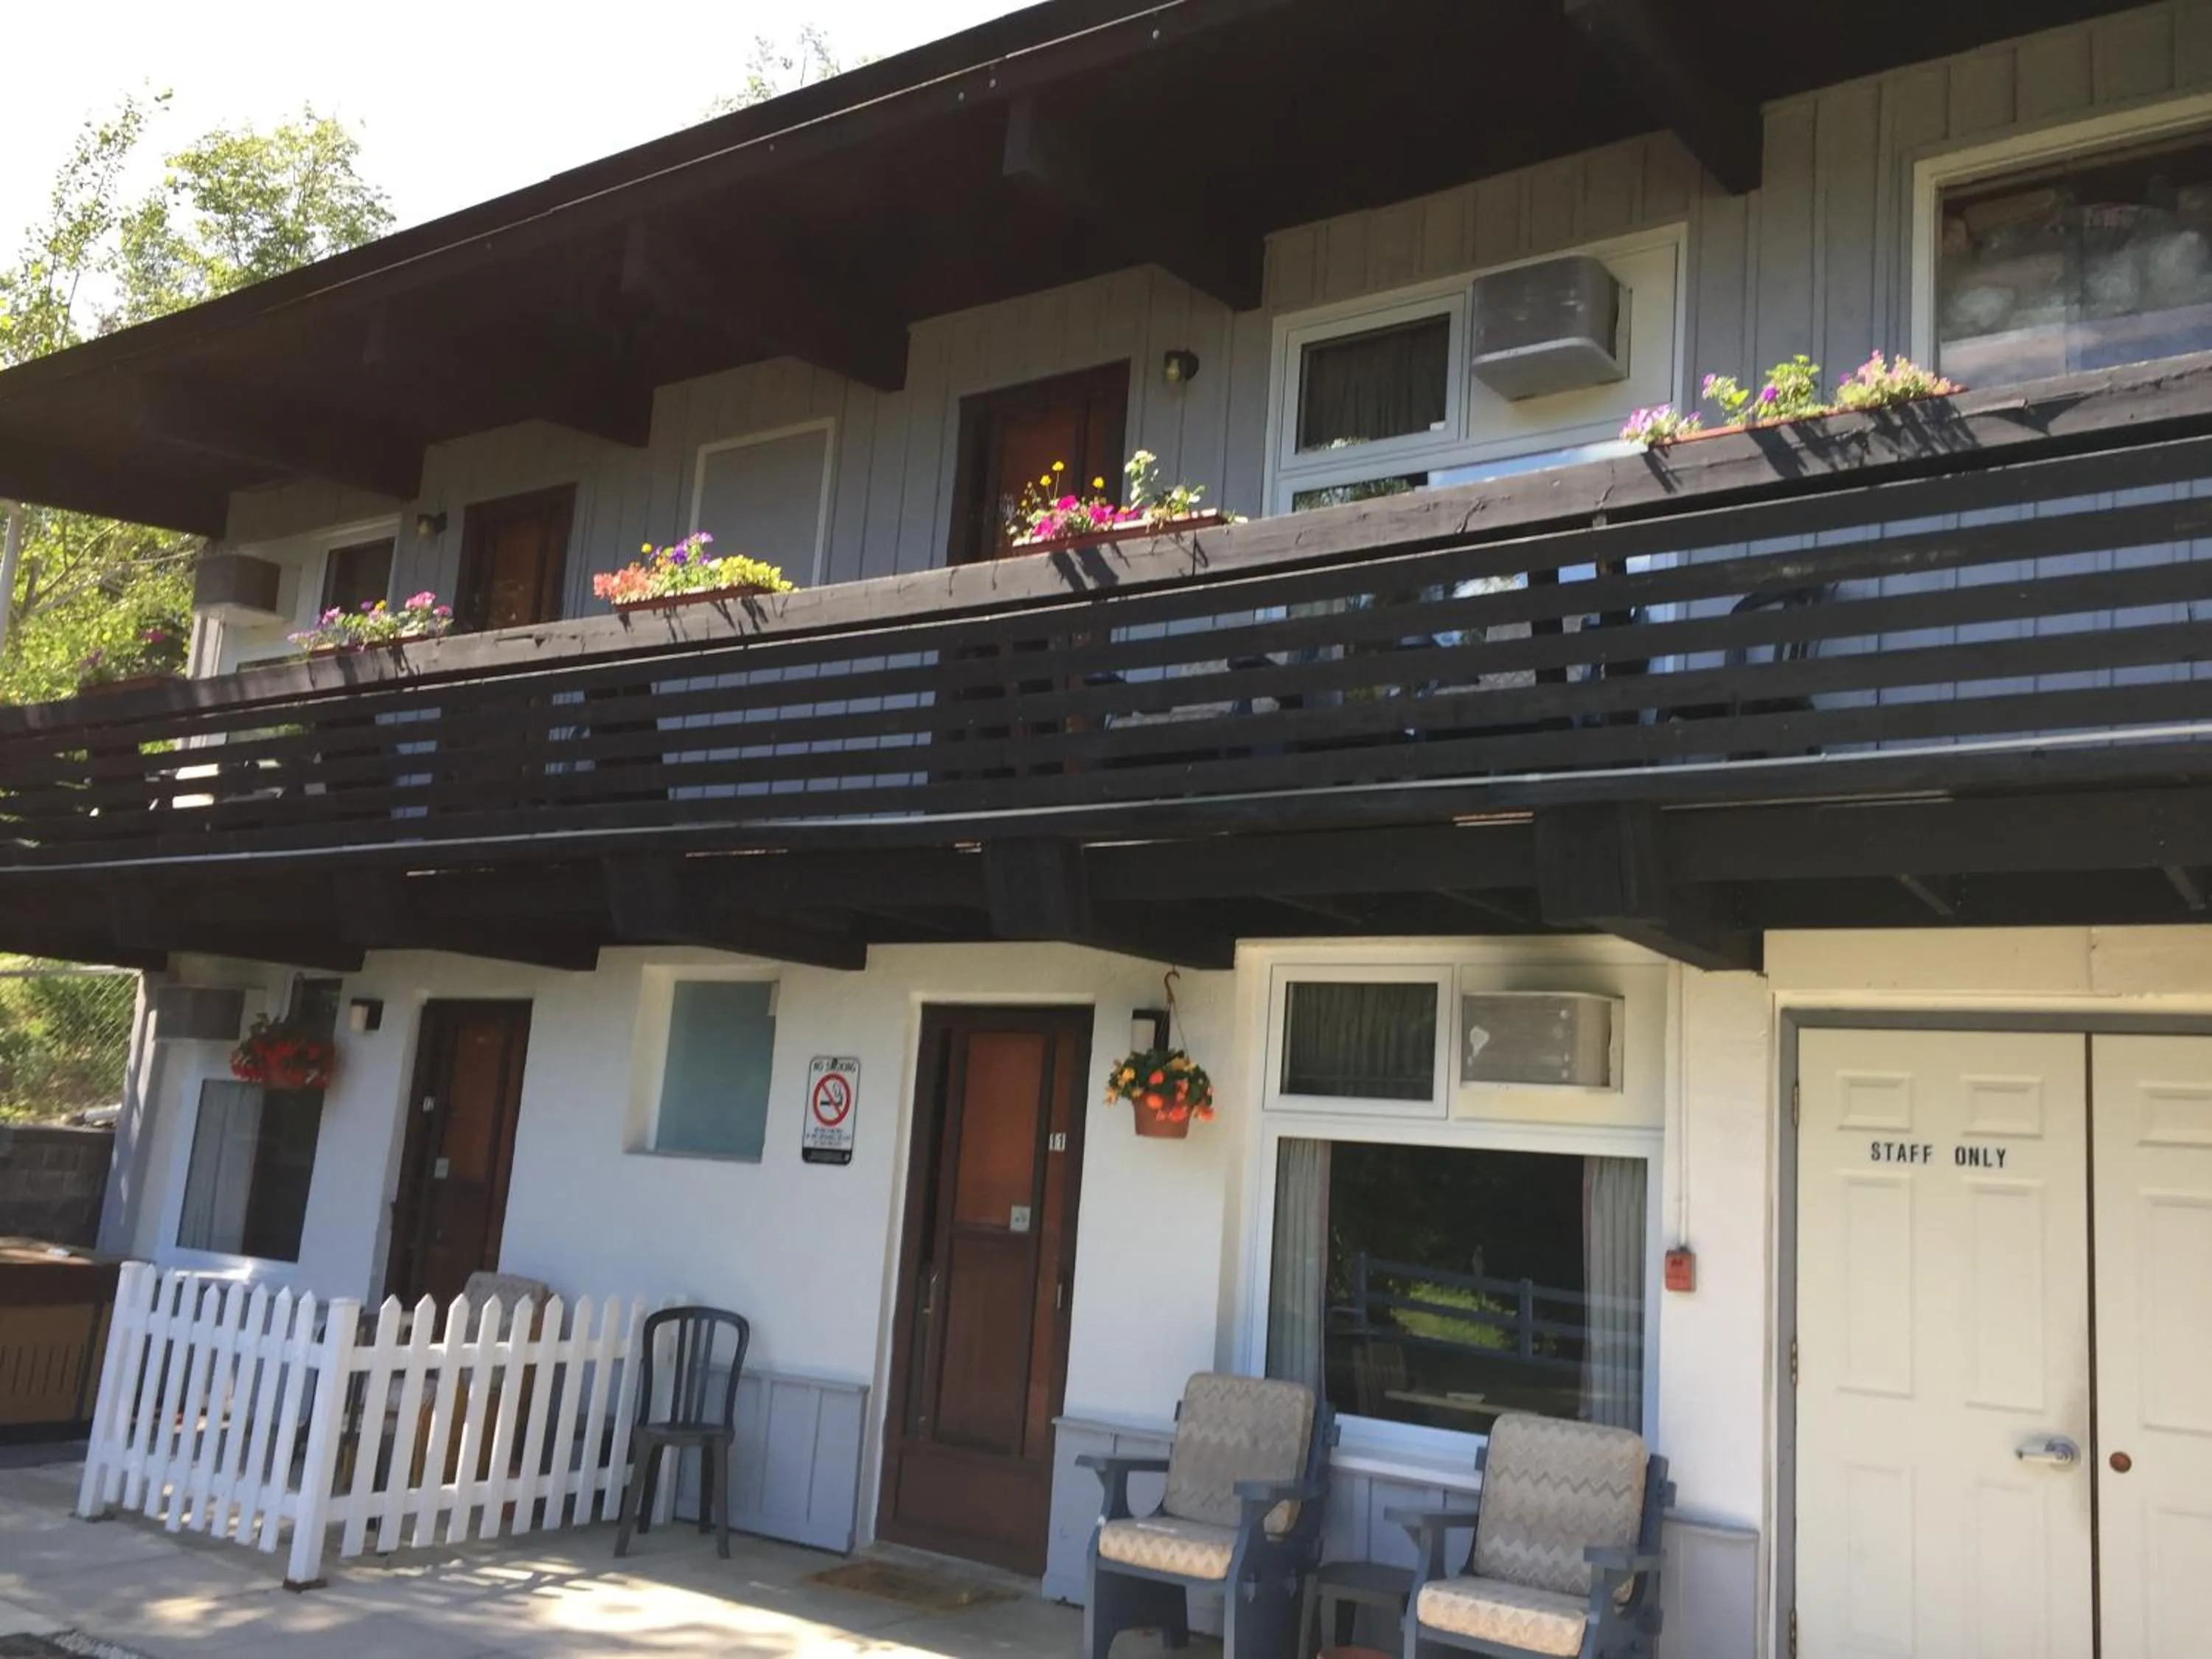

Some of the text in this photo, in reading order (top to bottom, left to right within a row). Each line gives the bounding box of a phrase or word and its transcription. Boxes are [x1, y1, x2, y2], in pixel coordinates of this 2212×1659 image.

[813, 1061, 824, 1071] NO
[1871, 1141, 2006, 1168] STAFF ONLY
